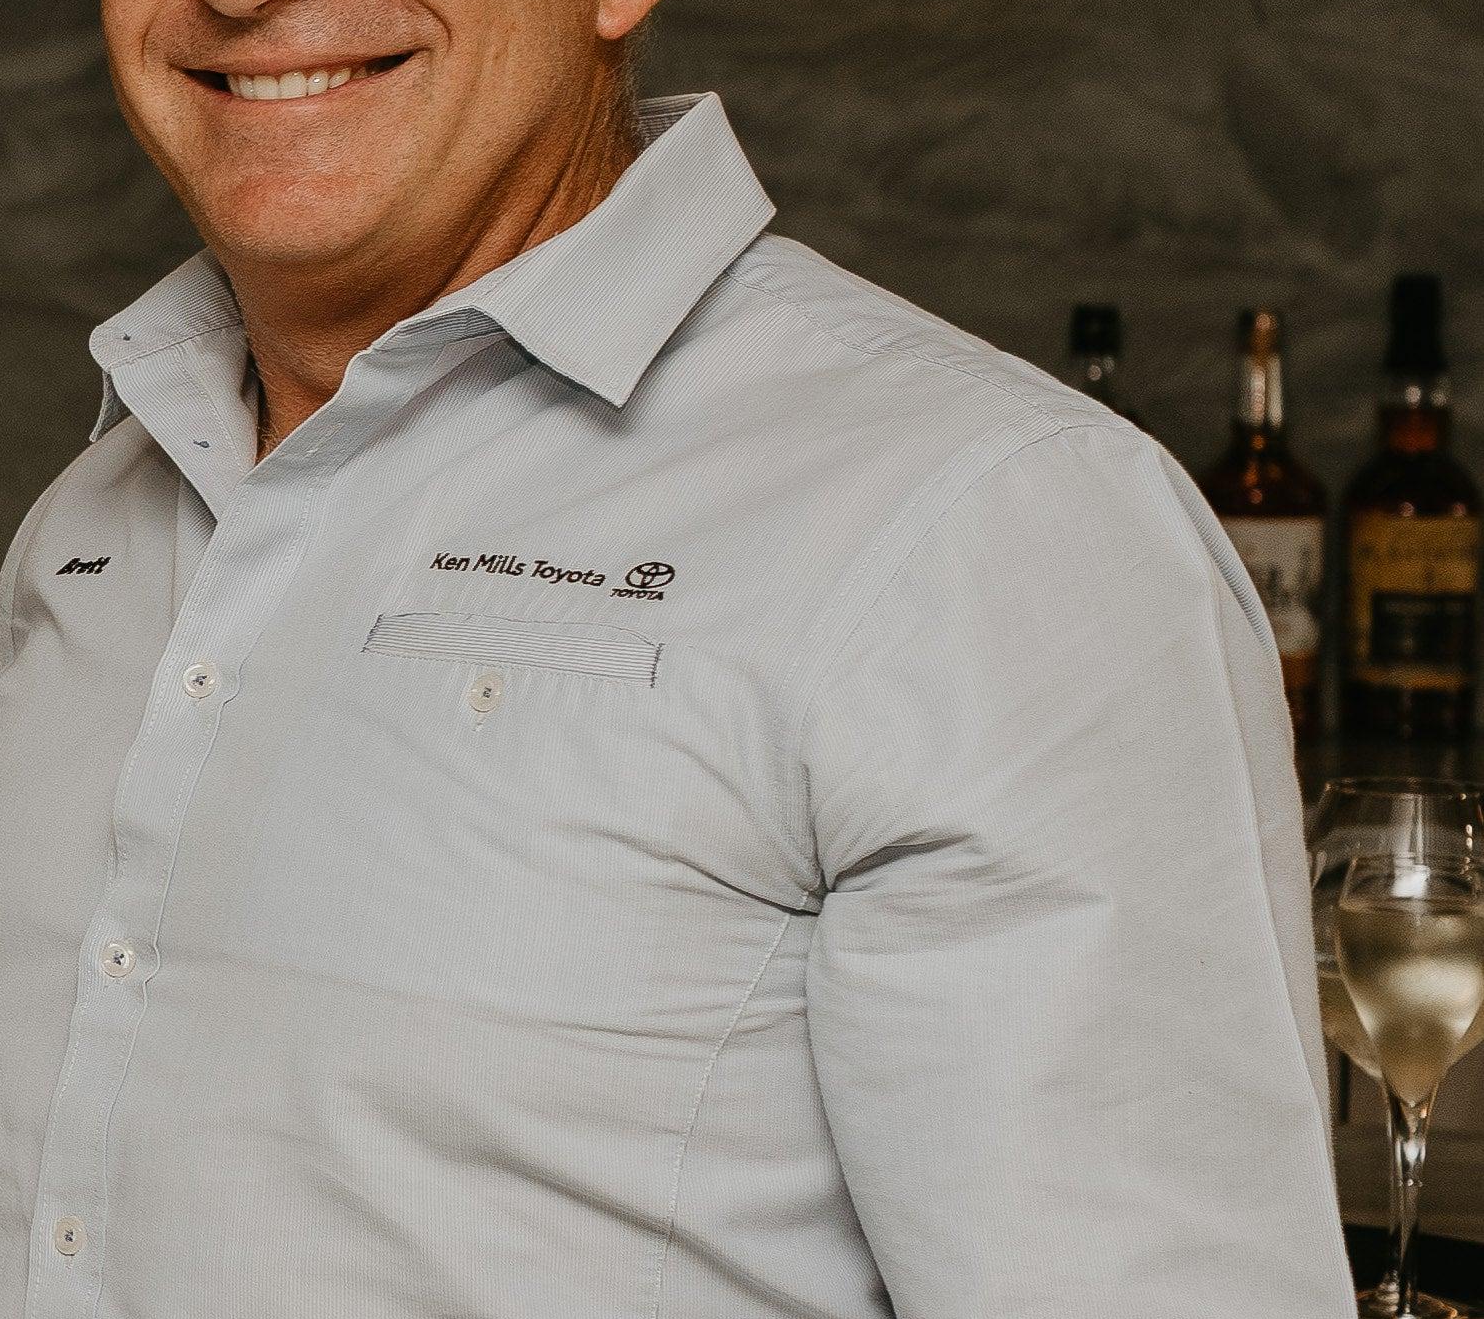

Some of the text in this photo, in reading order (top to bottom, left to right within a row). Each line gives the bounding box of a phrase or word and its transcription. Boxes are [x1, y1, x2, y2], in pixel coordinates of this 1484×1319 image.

[429, 552, 607, 587] Ken Mills Toyota
[609, 588, 665, 601] TOYOTA
